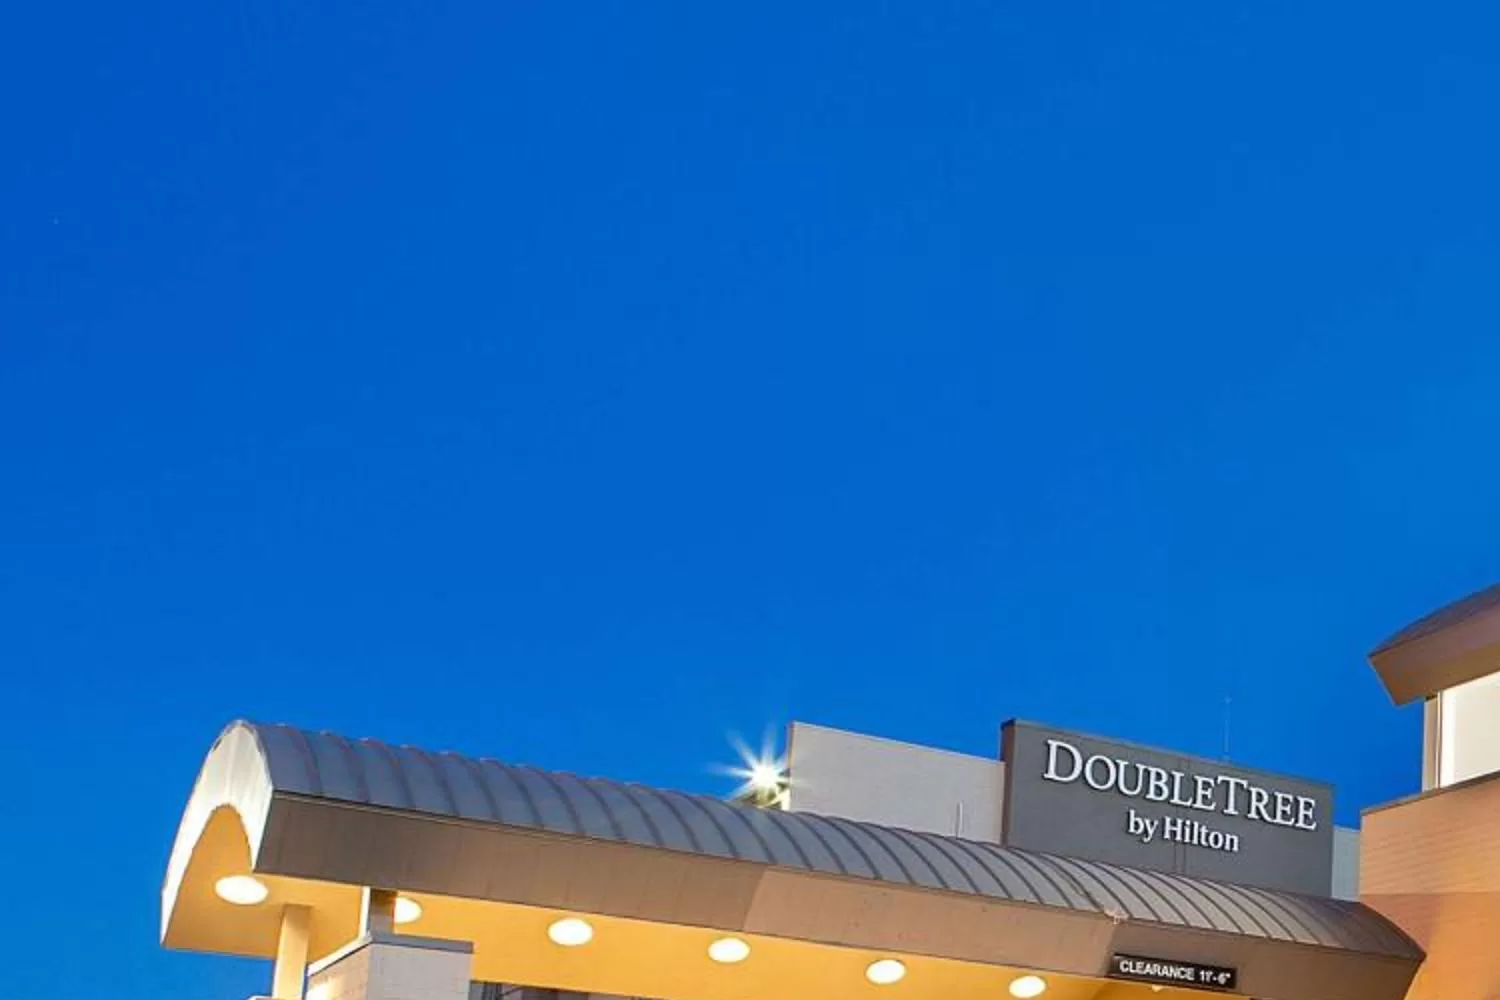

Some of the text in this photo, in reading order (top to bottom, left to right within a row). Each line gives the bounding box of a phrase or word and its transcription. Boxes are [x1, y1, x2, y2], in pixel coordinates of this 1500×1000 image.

[1127, 809, 1240, 852] by Hilton
[1119, 959, 1195, 981] CLEARANCE
